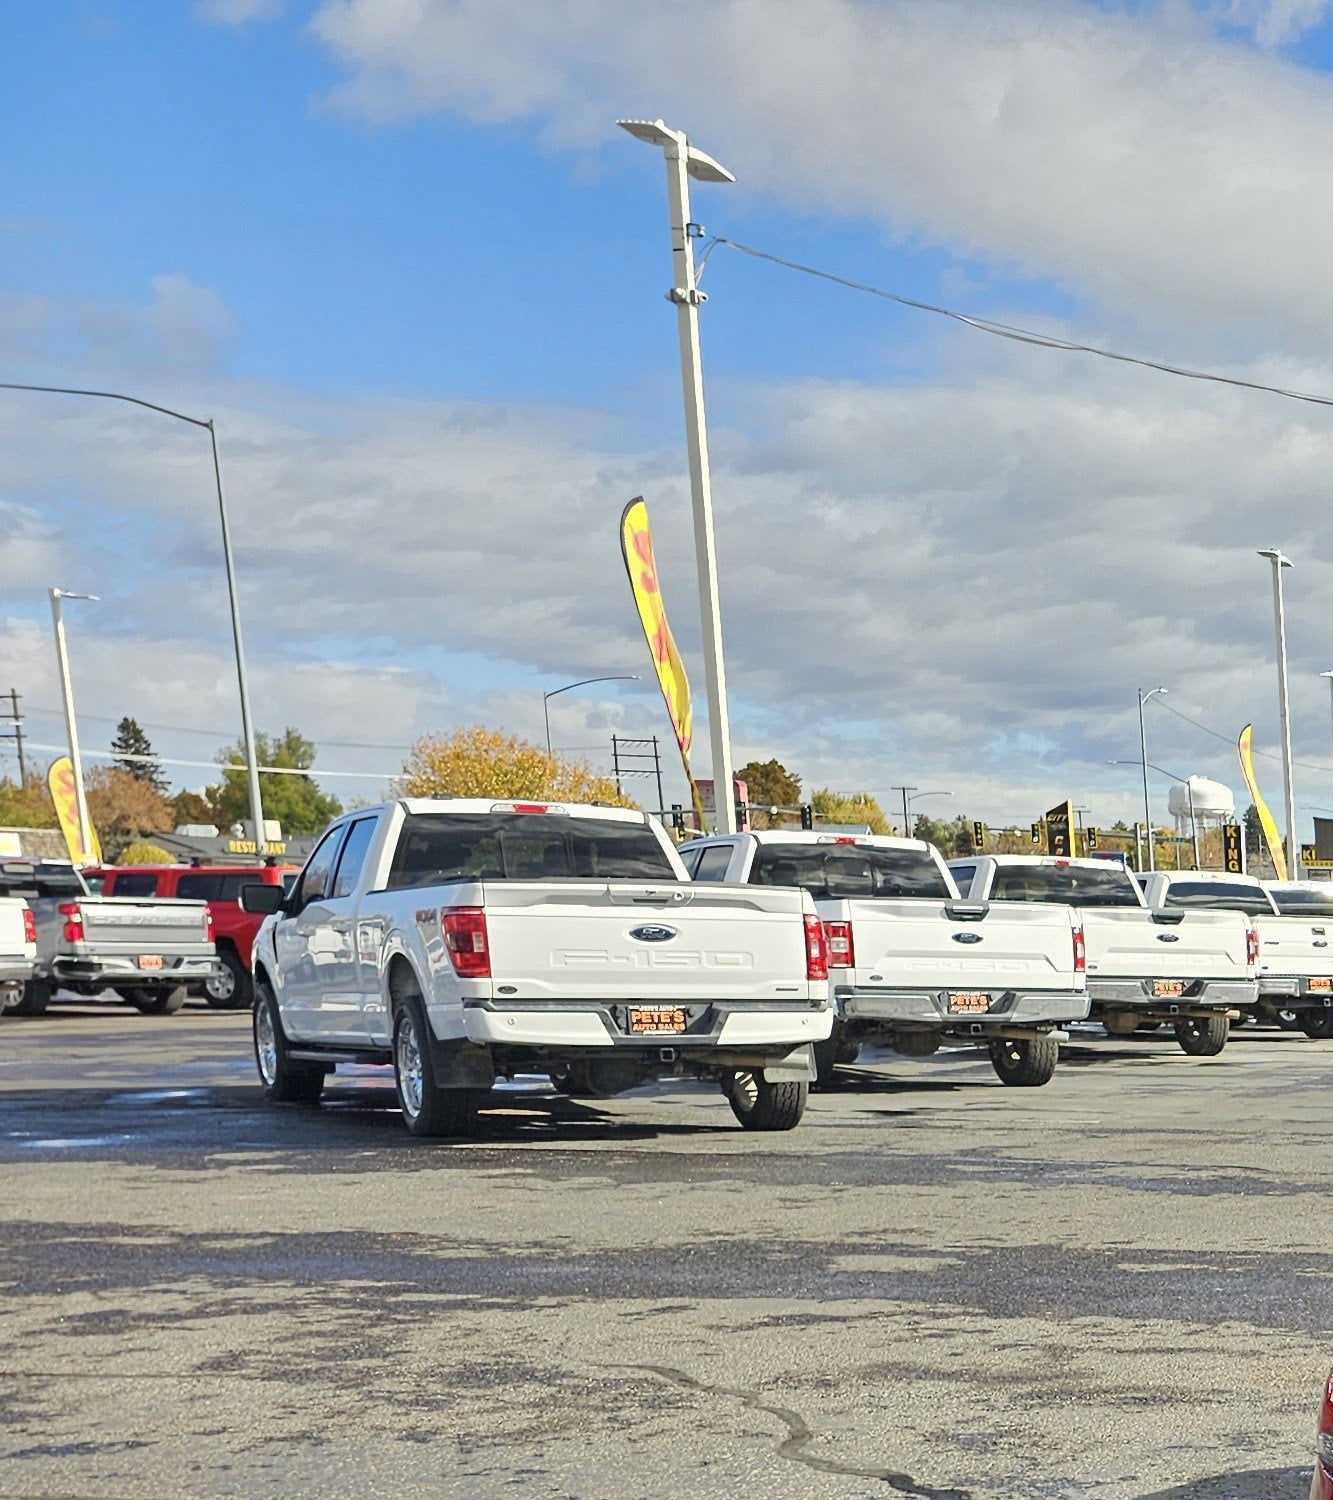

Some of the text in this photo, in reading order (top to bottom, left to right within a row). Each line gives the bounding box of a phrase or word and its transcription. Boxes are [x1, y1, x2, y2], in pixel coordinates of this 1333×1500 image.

[1227, 826, 1240, 872] KING
[550, 949, 754, 968] F-150
[631, 1011, 685, 1023] PETE'S
